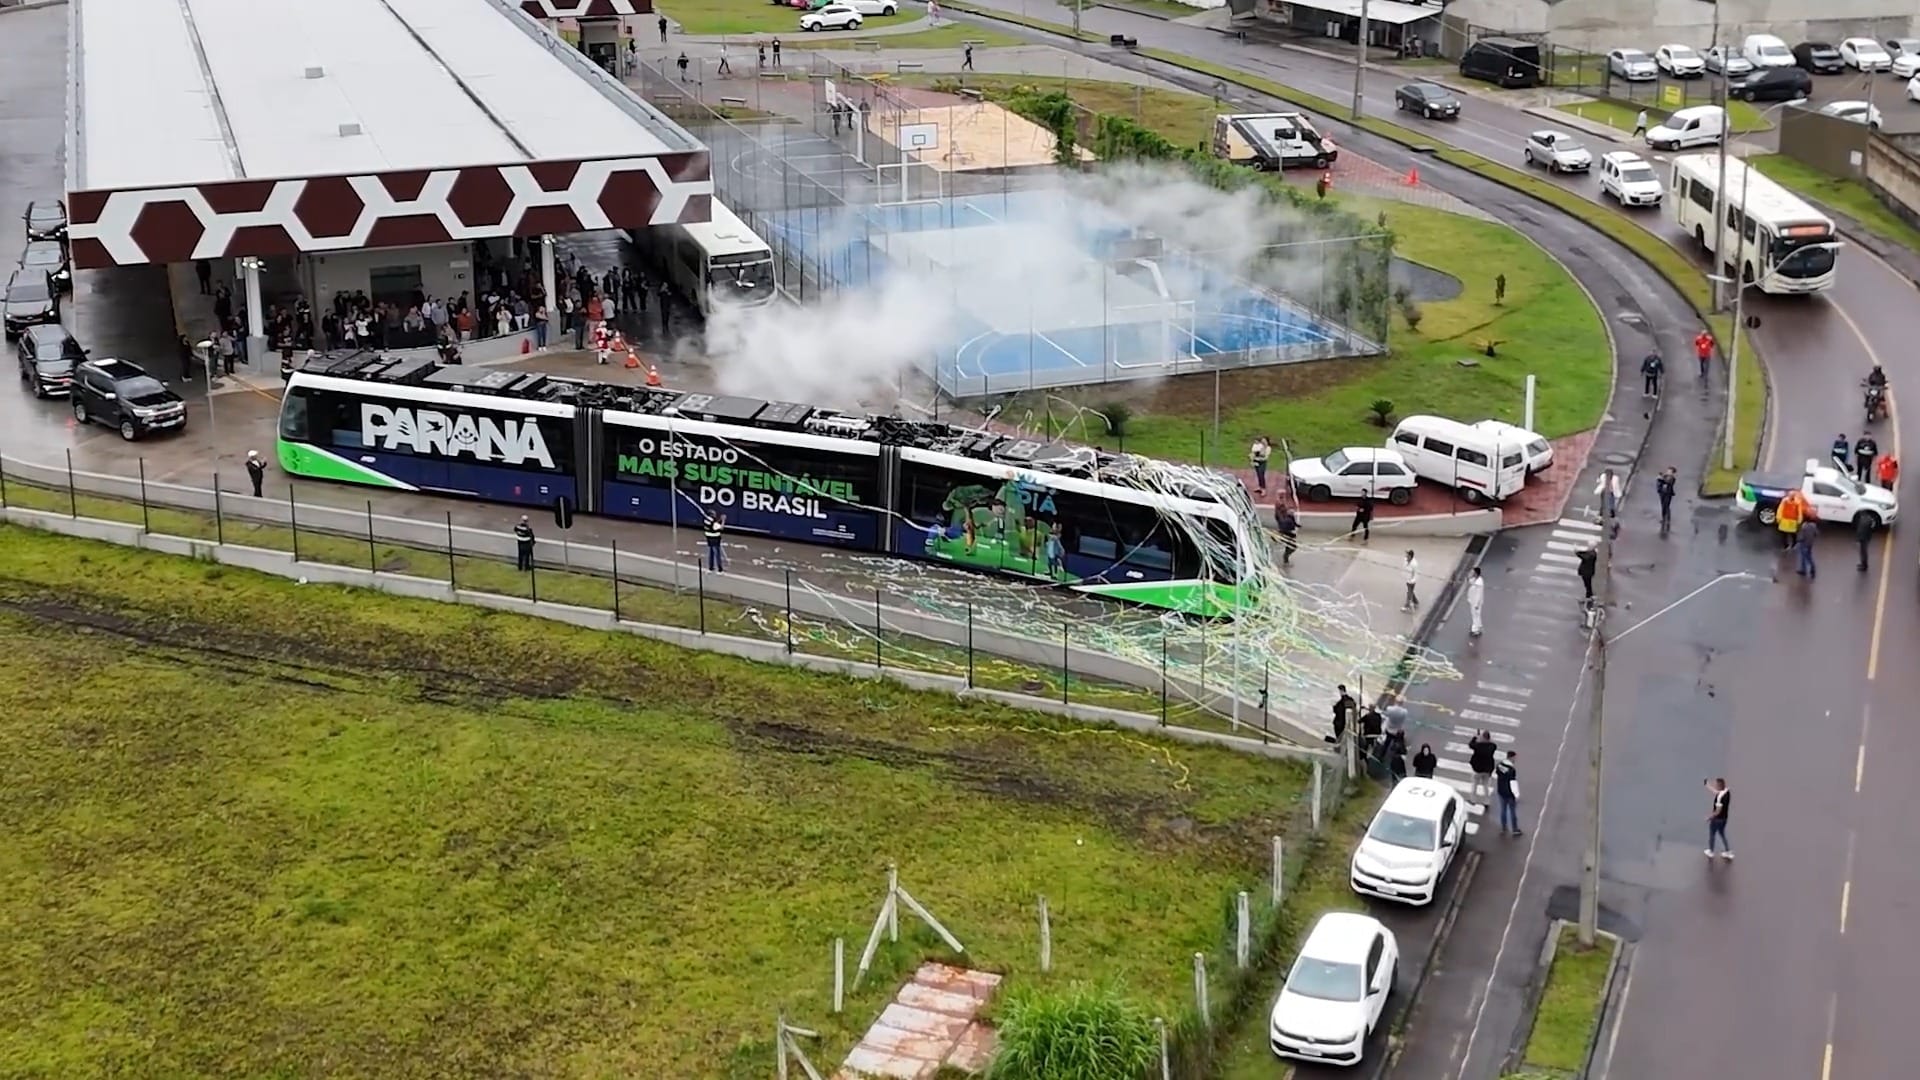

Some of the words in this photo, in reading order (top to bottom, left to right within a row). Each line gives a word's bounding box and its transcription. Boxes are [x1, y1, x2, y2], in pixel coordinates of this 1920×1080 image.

[361, 402, 555, 469] PARANÁ
[638, 438, 656, 455] O
[660, 440, 739, 464] ESTADO
[618, 454, 679, 479] MAIS
[684, 462, 861, 502] SUSTENTÁVEL
[700, 486, 735, 507] DO
[742, 492, 828, 519] BRASIL
